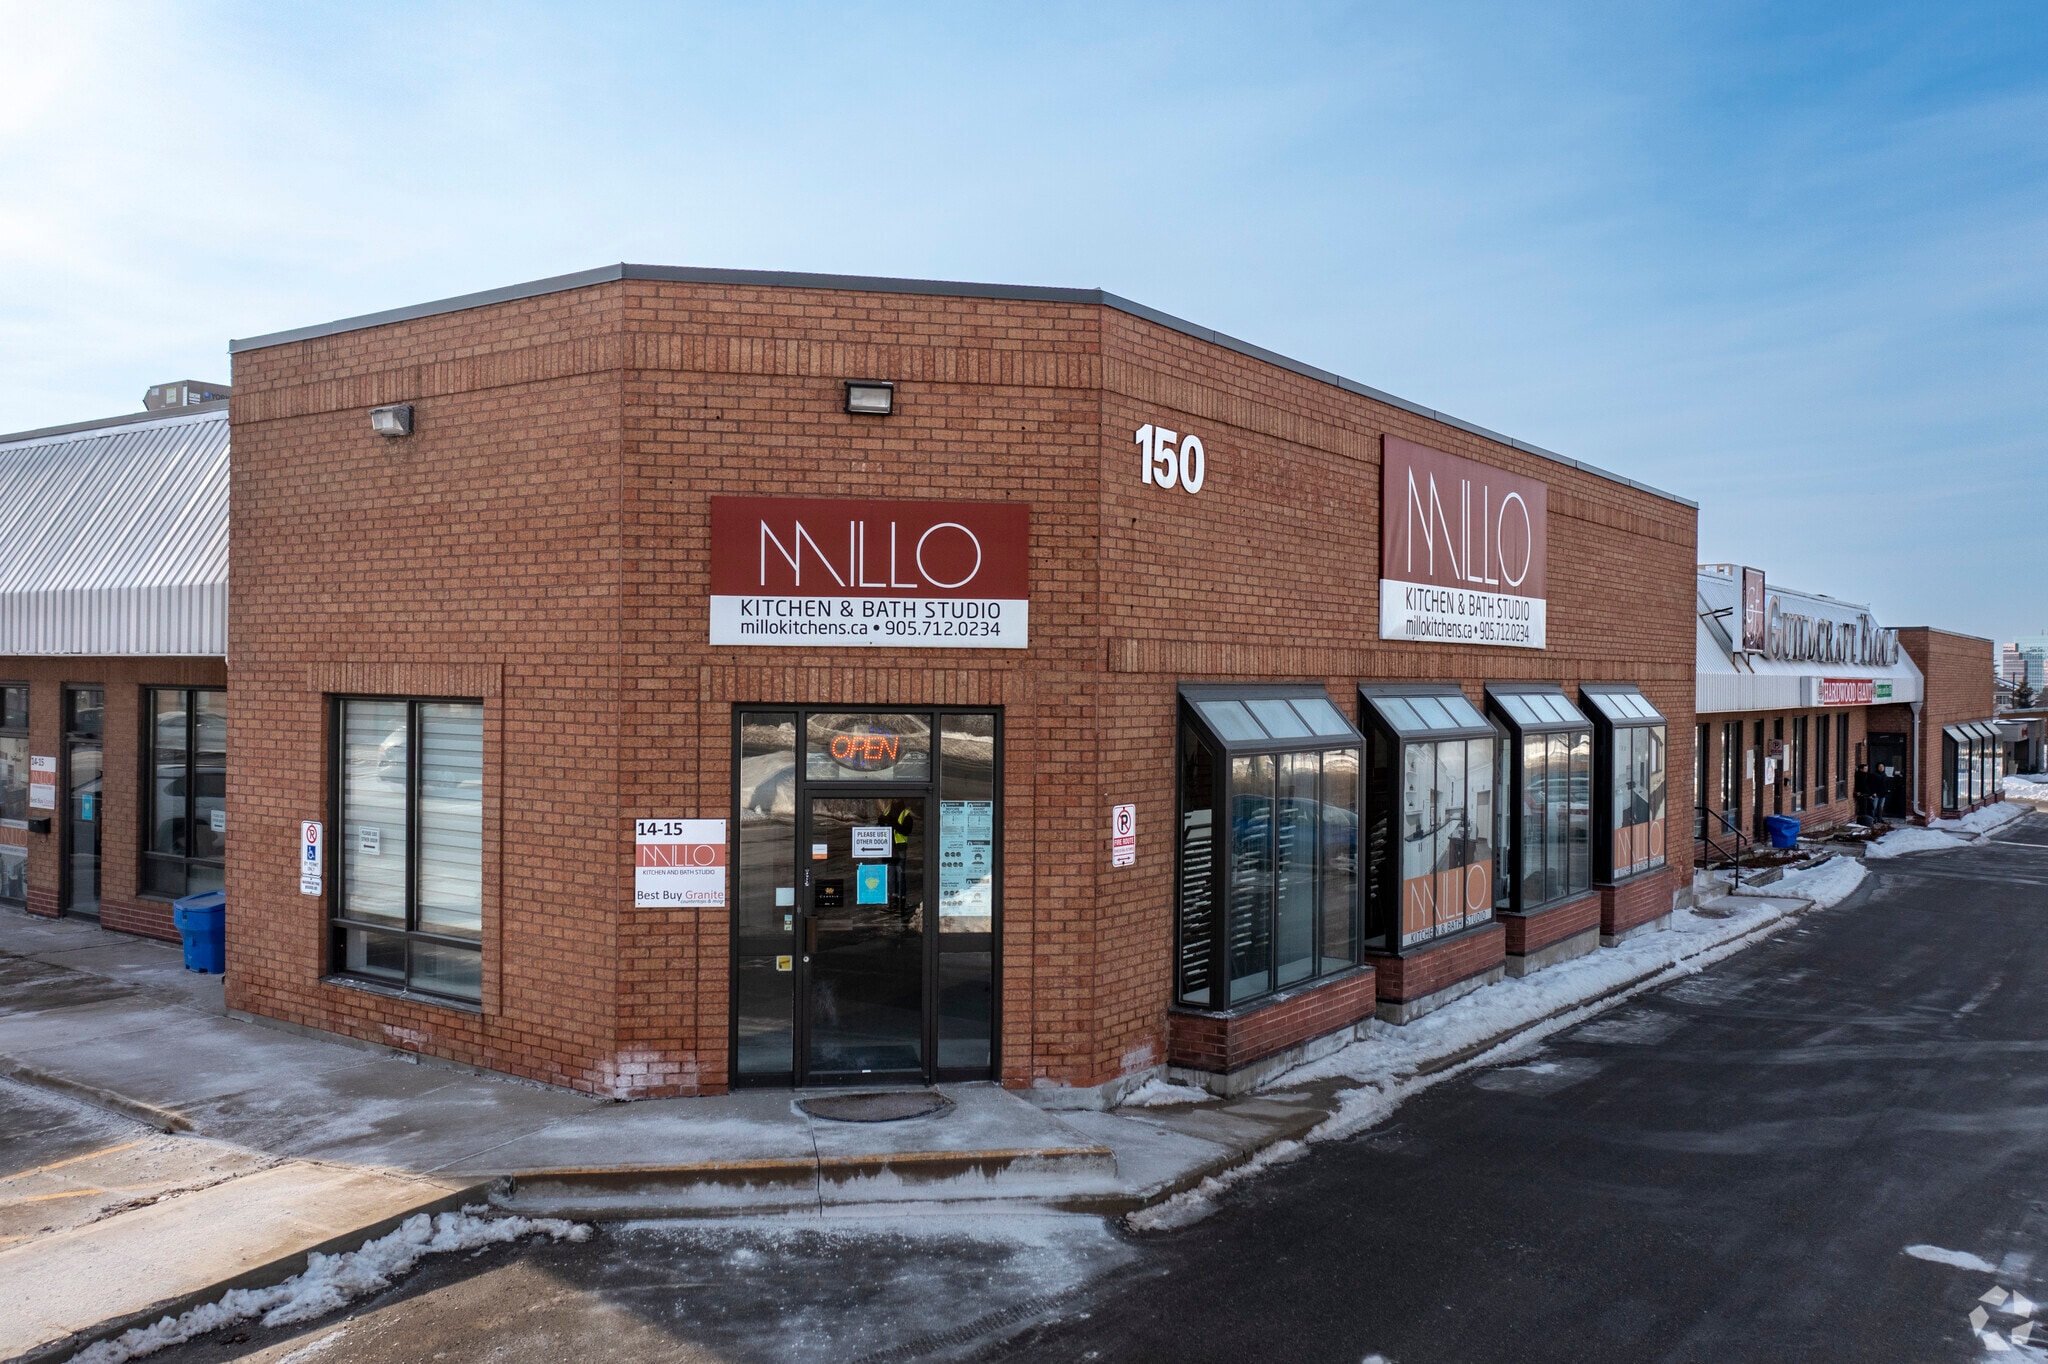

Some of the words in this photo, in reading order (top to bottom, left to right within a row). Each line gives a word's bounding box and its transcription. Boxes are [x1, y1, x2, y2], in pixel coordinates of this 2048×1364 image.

[1135, 423, 1205, 494] 150
[1408, 464, 1531, 587] MILLO
[760, 519, 982, 589] MILLO
[740, 599, 831, 617] KITCHEN
[840, 601, 854, 618] &
[862, 600, 917, 618] BATH
[924, 602, 1001, 619] STUDIO
[1405, 586, 1454, 614] KITCHEN
[1457, 593, 1466, 615] &
[1469, 594, 1494, 618] BATH
[1497, 595, 1530, 621] STUDIO
[740, 619, 868, 635] millokitchens.ca
[885, 620, 1001, 637] 905.712.0234
[1405, 615, 1473, 639] millokitchens.ca
[1479, 621, 1530, 643] 905.712.0234
[1824, 682, 1857, 703] HARDWOOD
[831, 735, 899, 760] OPEN
[638, 822, 683, 836] 14-15
[643, 844, 716, 867] MILLO
[1617, 821, 1662, 867] MILLO
[637, 890, 660, 900] Best
[663, 890, 682, 901] Buy
[685, 890, 724, 900] Granite
[1411, 864, 1487, 930] MILLO
[1410, 925, 1440, 943] KITCHEN
[1440, 923, 1446, 933] &
[1447, 919, 1462, 931] BATH
[1466, 910, 1487, 926] STUDIO
